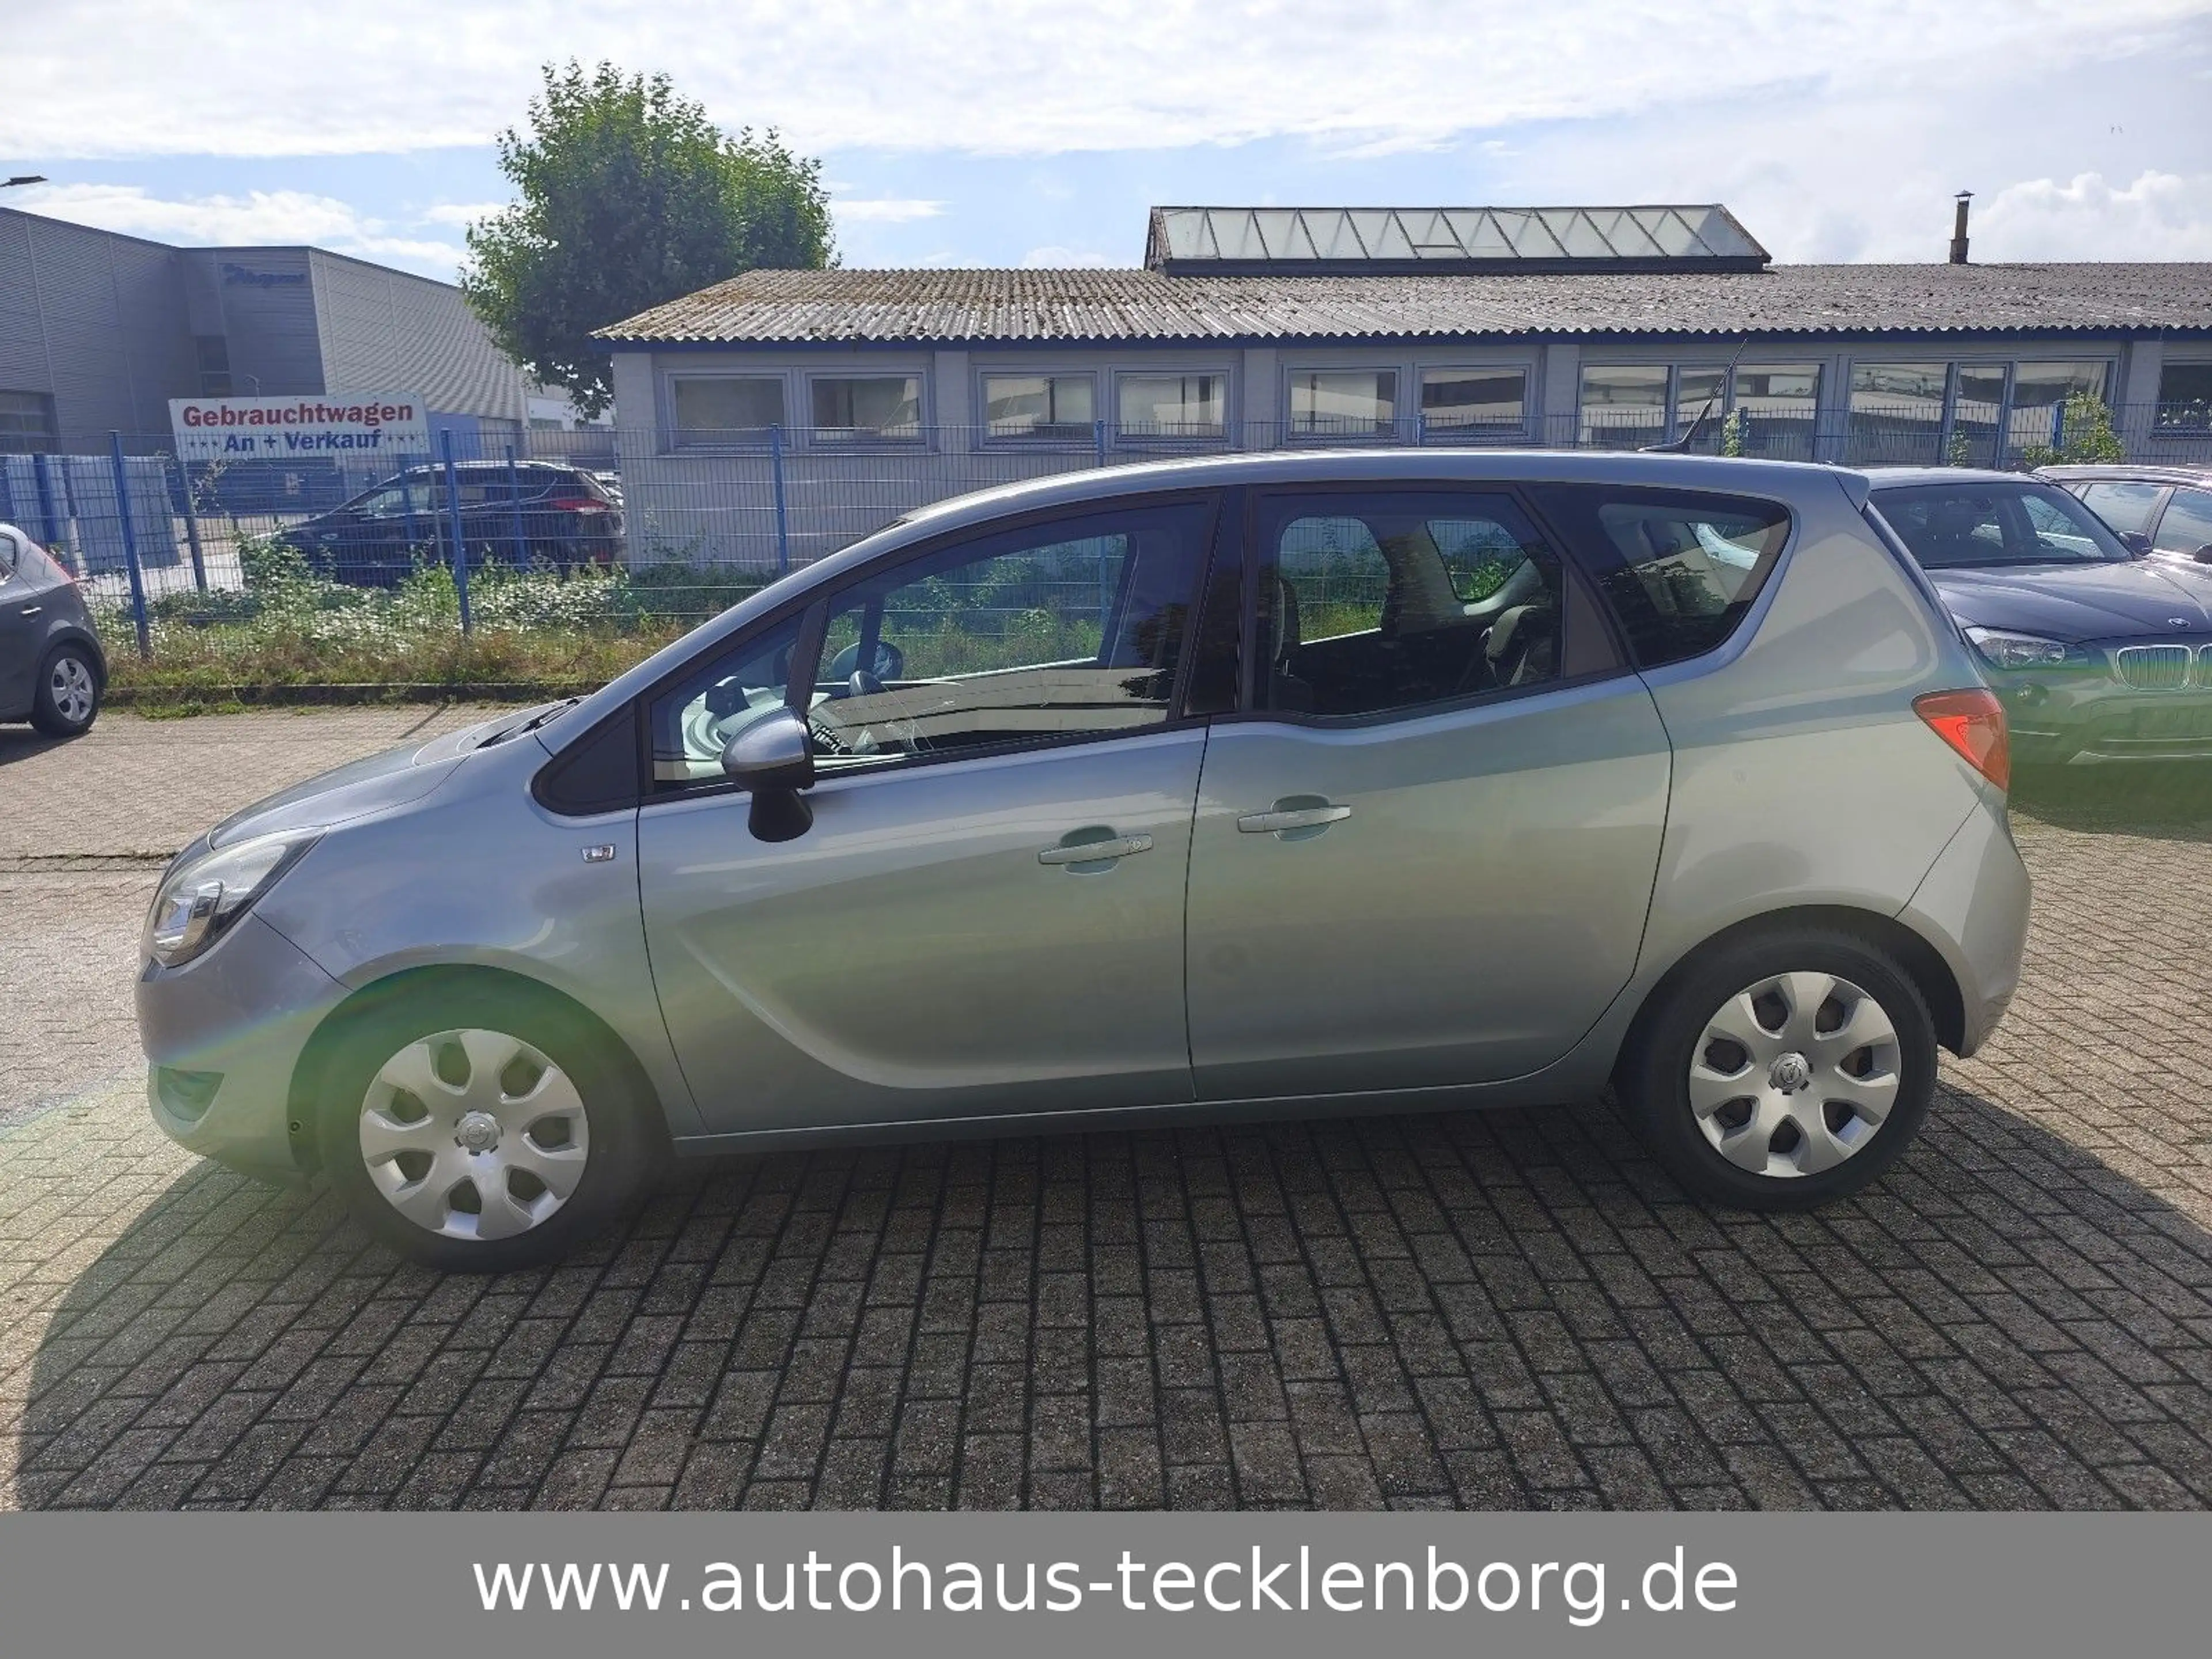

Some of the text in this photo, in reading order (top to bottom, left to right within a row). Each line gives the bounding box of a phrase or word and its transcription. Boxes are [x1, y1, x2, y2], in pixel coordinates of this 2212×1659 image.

[183, 402, 413, 427] Gebrauchtwagen
[224, 429, 382, 452] An + Verkauf
